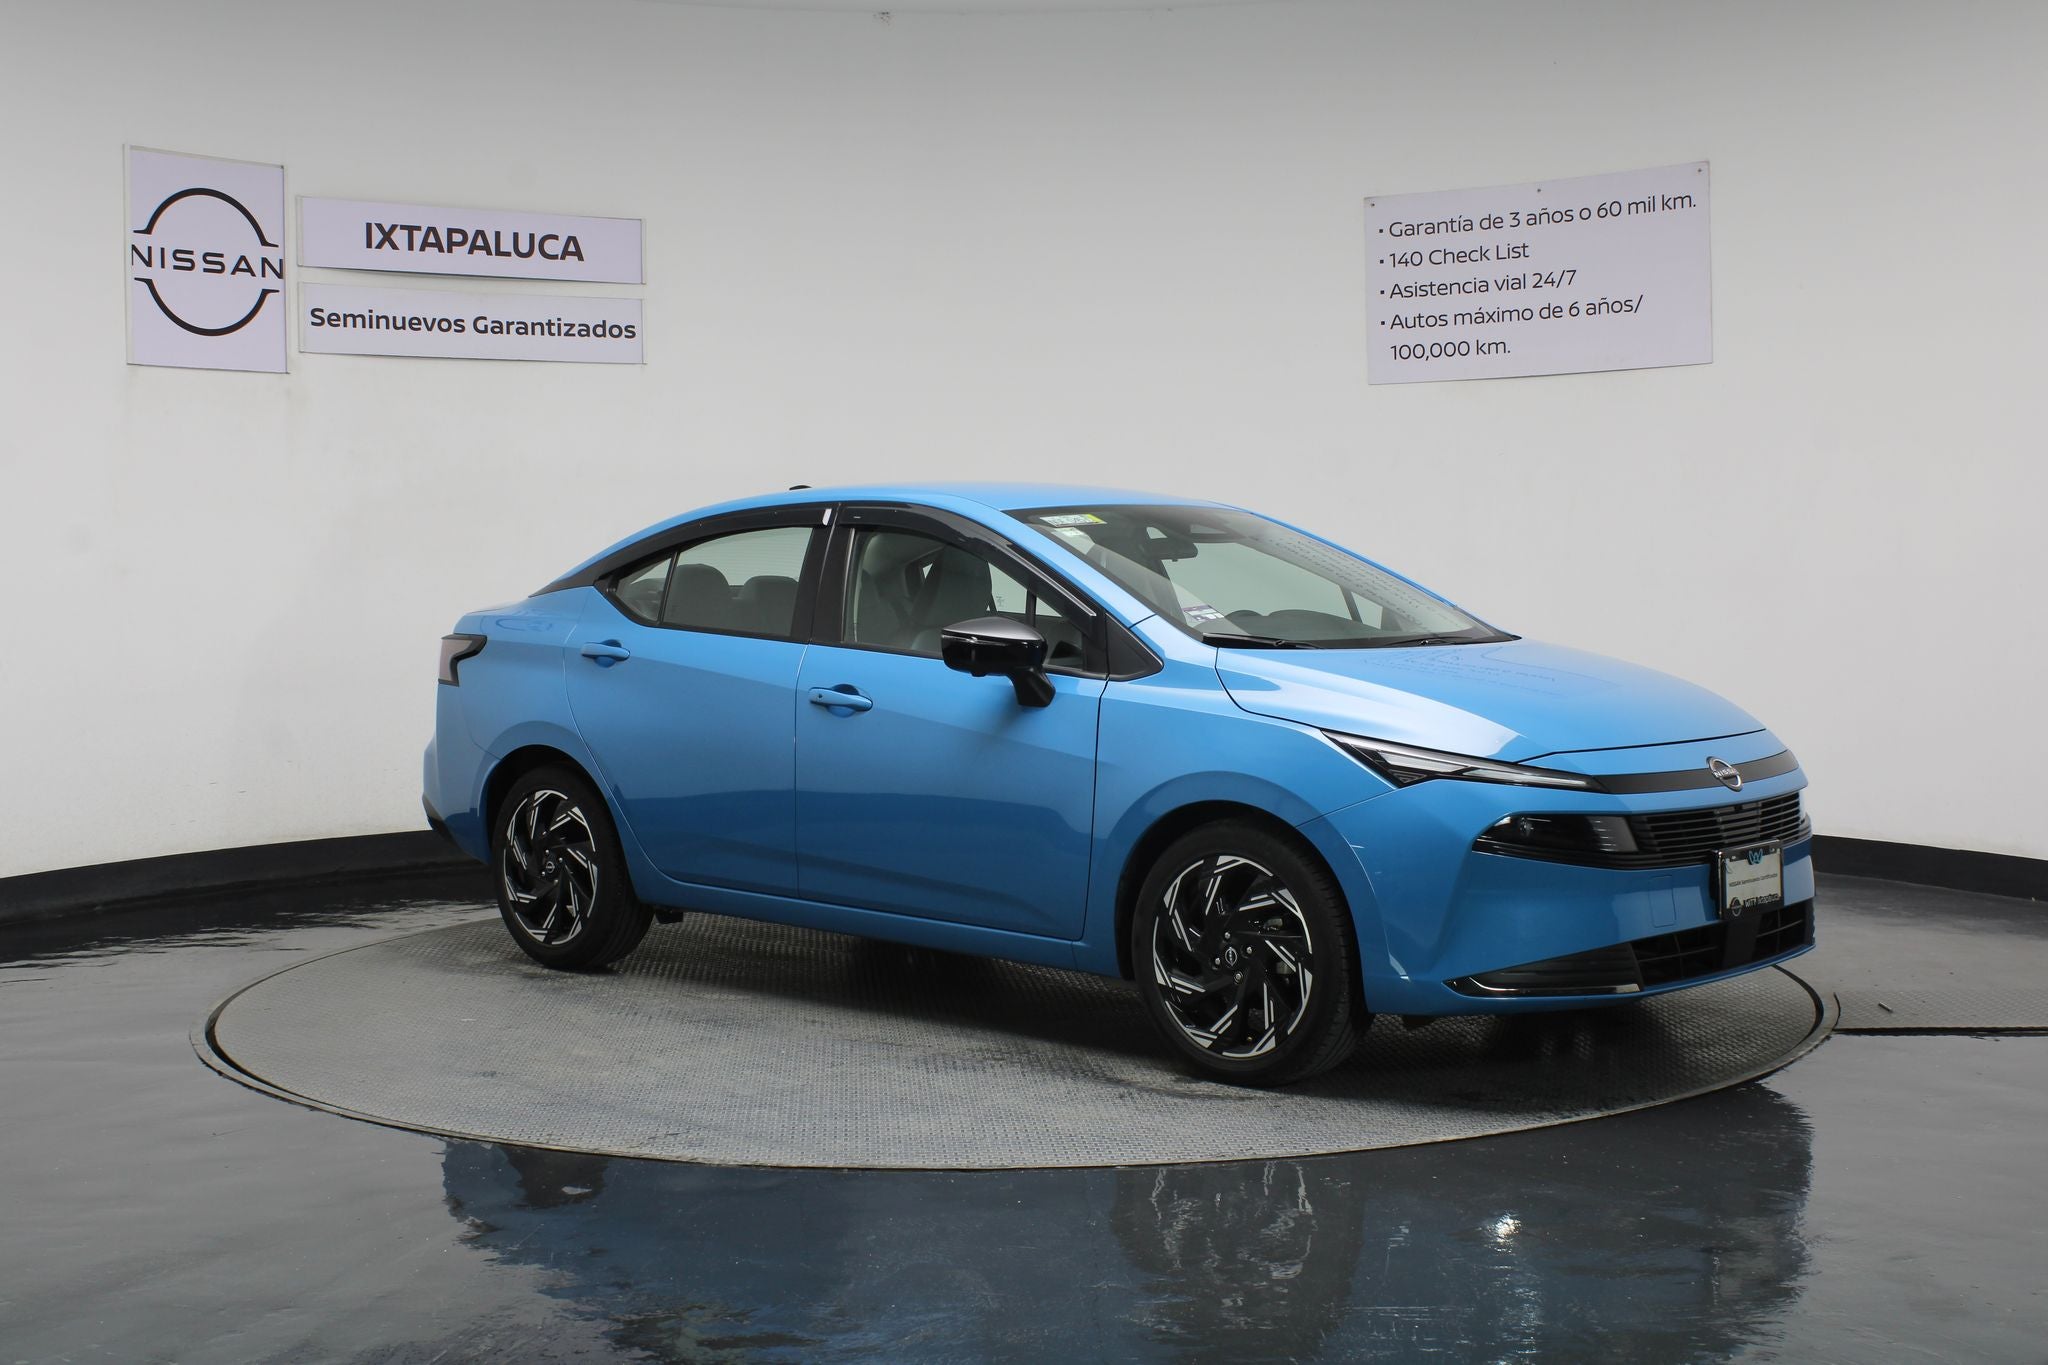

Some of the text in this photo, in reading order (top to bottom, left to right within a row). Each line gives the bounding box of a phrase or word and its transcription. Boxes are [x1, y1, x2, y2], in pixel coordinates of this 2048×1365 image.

[1389, 194, 1697, 238] Garantía de 3 años o 60 mil km.
[365, 222, 585, 262] IXTAPALUCA
[1389, 242, 1530, 268] 140 Check List
[131, 243, 285, 280] NISSAN
[1389, 269, 1577, 299] Asistencia vial 24/7
[310, 307, 637, 340] Seminuevos Garantizados
[1389, 294, 1644, 330] Autos máximo de 6 años/
[1390, 339, 1511, 362] 100,000 km.
